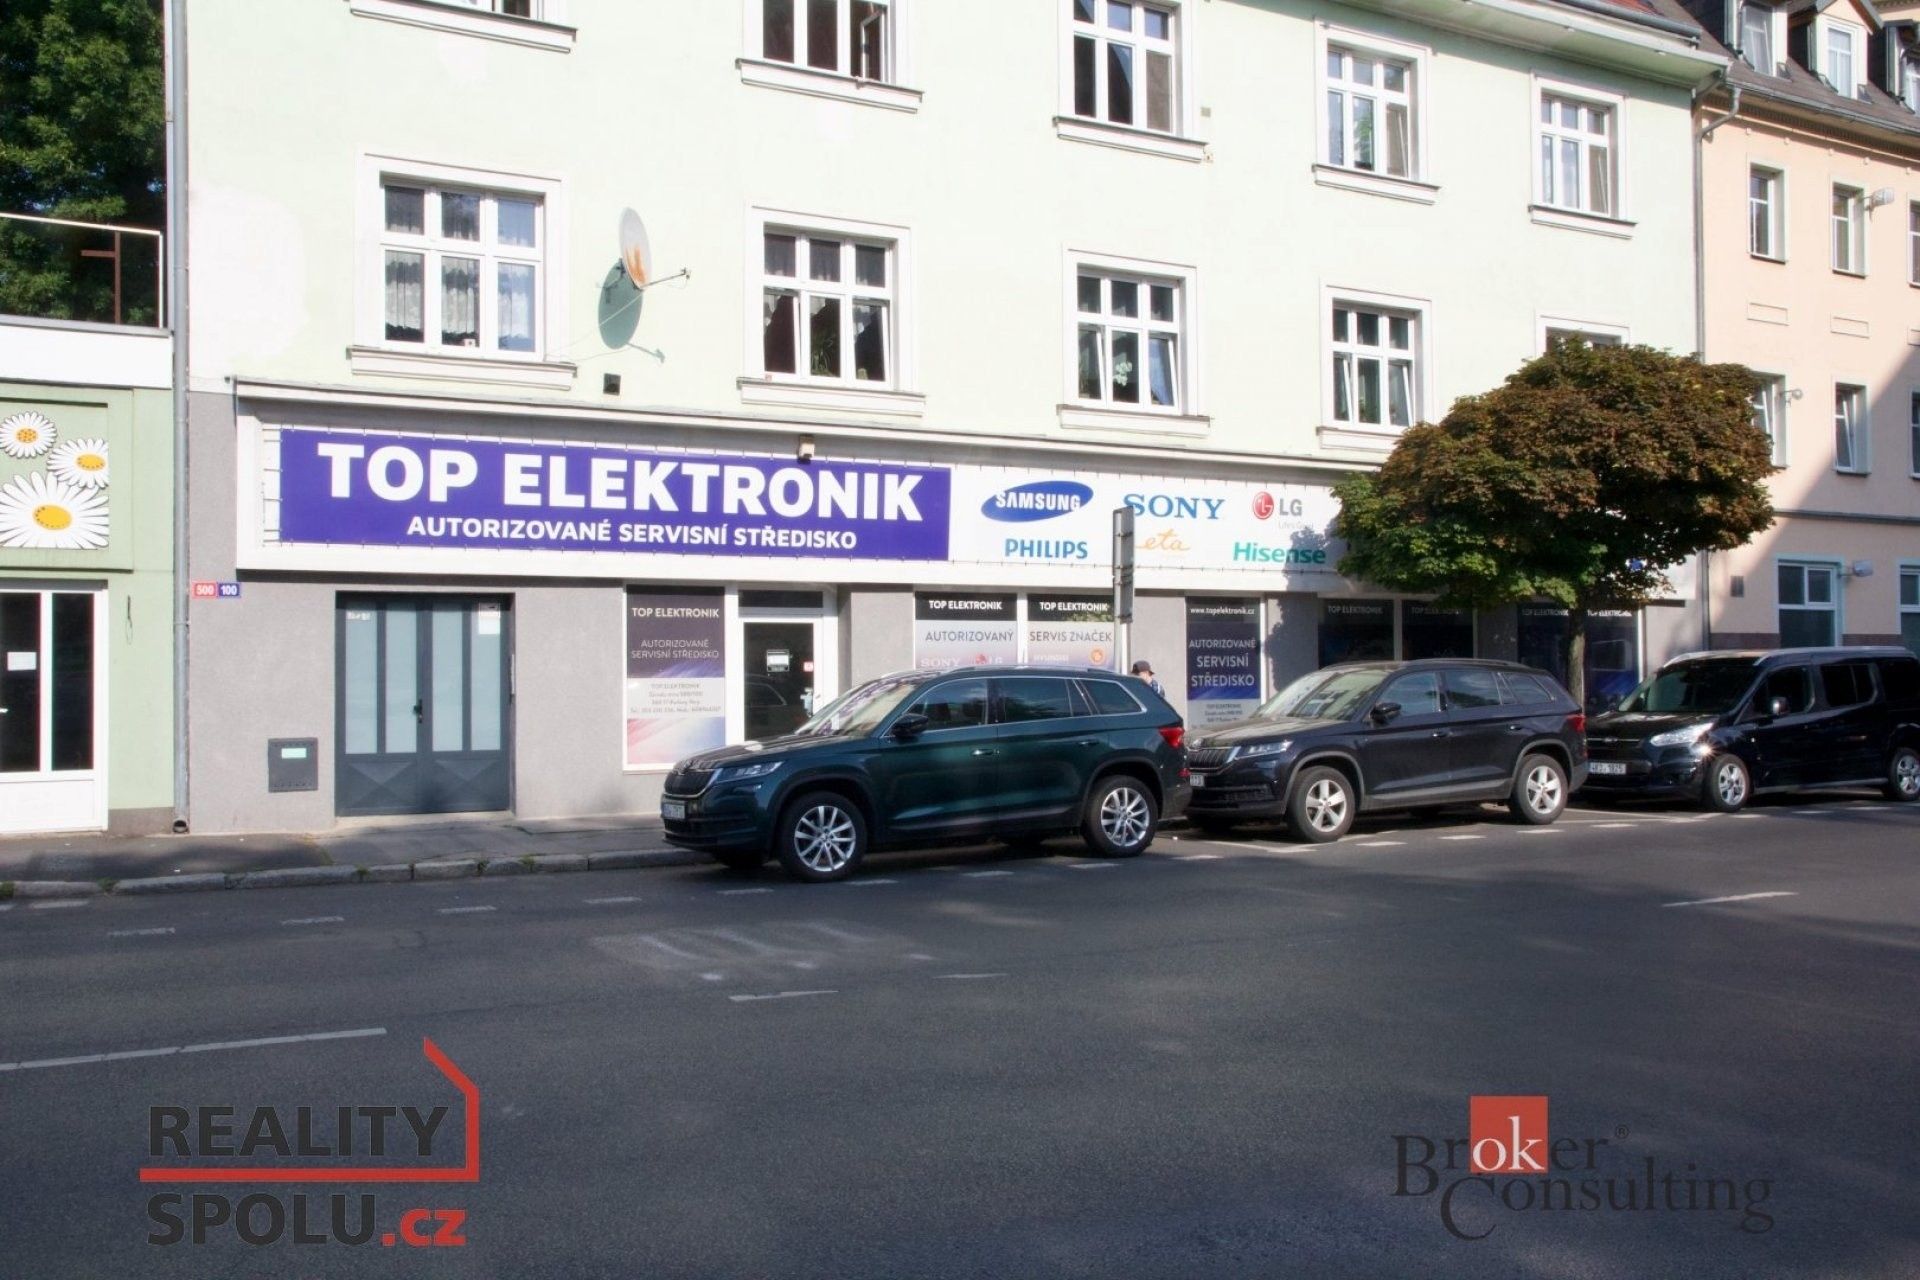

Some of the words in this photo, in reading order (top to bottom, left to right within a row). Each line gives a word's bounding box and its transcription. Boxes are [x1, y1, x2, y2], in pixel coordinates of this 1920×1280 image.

[317, 441, 478, 503] TOP
[503, 454, 923, 521] ELEKTRONIK
[995, 490, 1081, 511] SAMSUNG
[1123, 493, 1226, 519] SONY
[1279, 499, 1303, 517] LG
[406, 515, 612, 542] AUTORIZOVANÉ
[618, 522, 728, 546] SERVISNÍ
[733, 524, 858, 550] STŘEDISKO
[1135, 528, 1191, 551] eta
[1004, 538, 1089, 559] PHILIPS
[1233, 541, 1327, 565] Hisense
[196, 584, 214, 596] 500
[220, 583, 237, 596] 100
[631, 607, 653, 617] TOP
[655, 607, 720, 617] ELEKTRONIK
[929, 600, 947, 610] TOP
[948, 600, 1003, 611] ELEKTRONIK
[1039, 601, 1057, 611] TOP
[1058, 601, 1109, 612] ELEKTRONIK
[925, 628, 1015, 642] AUTORIZOVANÝ
[1029, 630, 1068, 642] SERVIS
[1070, 628, 1113, 642] ZNAČEK
[640, 639, 710, 649] AUTORIZOVANÉ
[1188, 637, 1257, 649] AUTORIZOVANÉ
[631, 648, 671, 659] SERVISNÍ
[672, 648, 720, 659] STŘEDISKO
[1196, 652, 1249, 668] SERVISNÍ
[1190, 672, 1255, 687] STŘEDISKO
